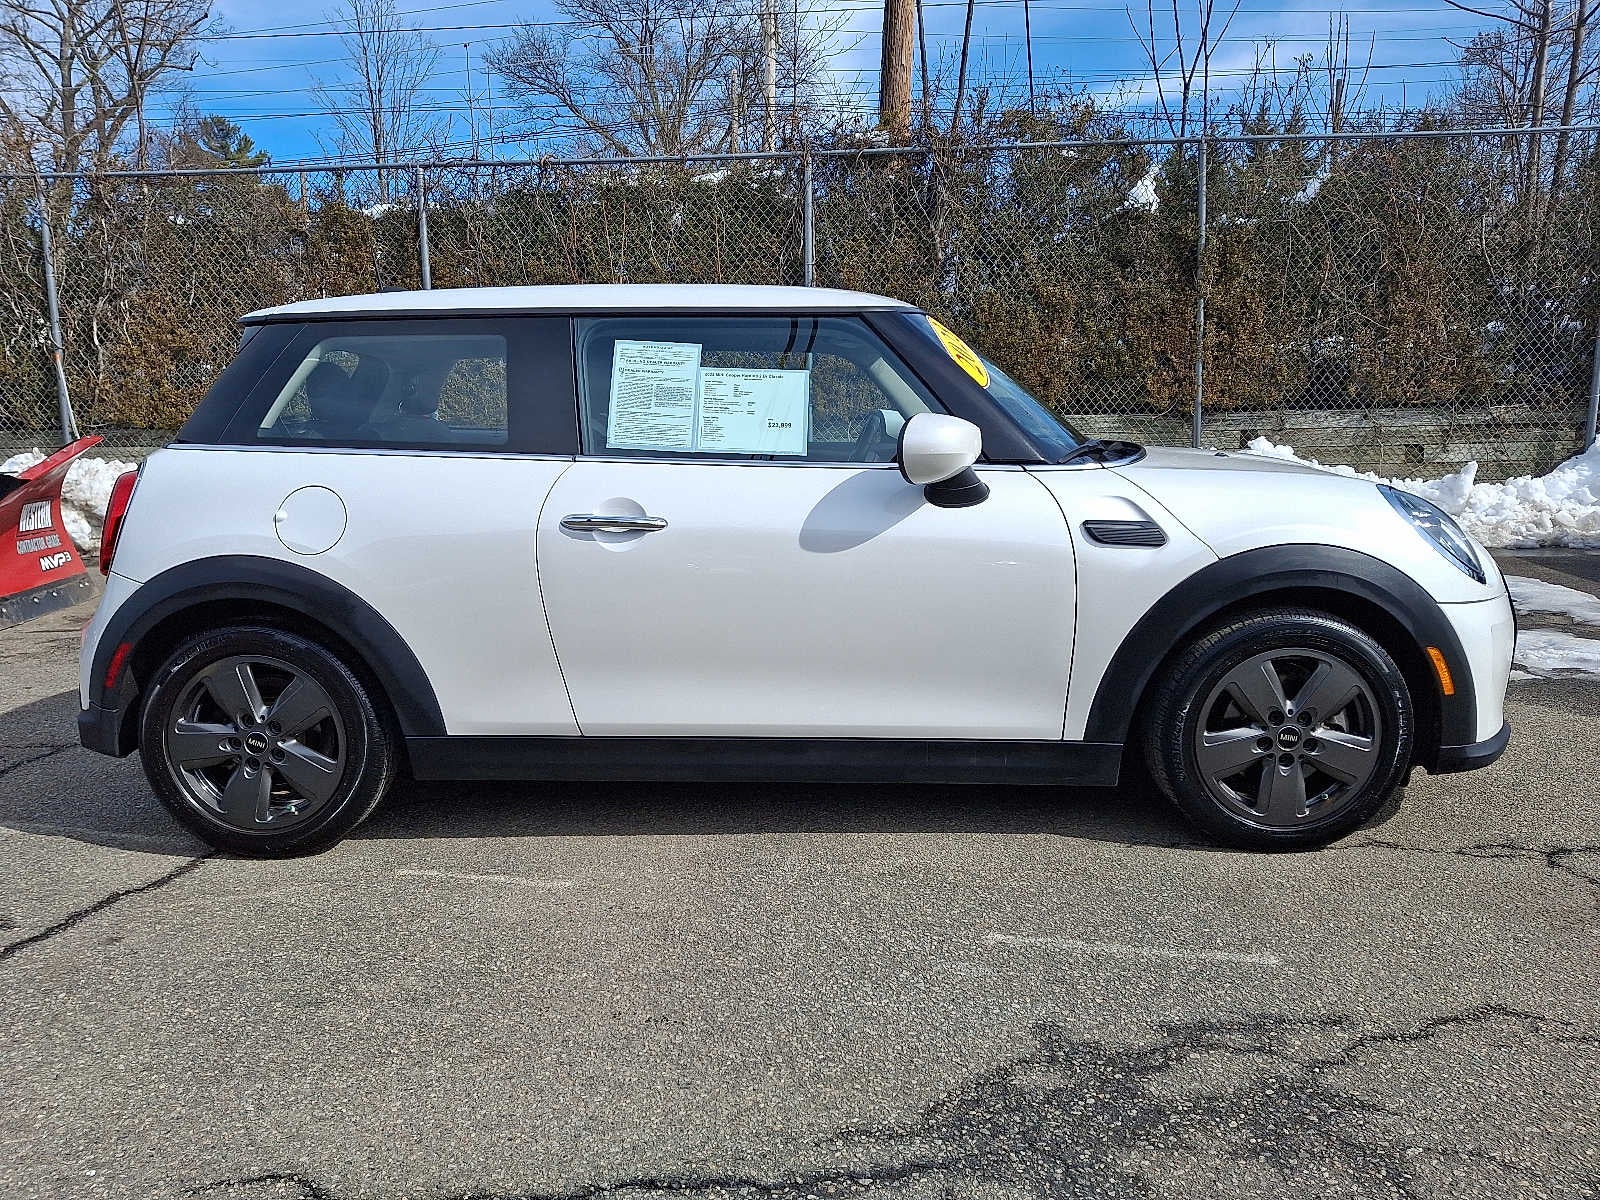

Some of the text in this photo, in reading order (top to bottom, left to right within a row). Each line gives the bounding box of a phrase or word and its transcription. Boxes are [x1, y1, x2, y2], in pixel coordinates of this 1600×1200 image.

[19, 500, 53, 532] WESTERN
[247, 737, 266, 749] MINI
[1279, 733, 1299, 742] MINI
